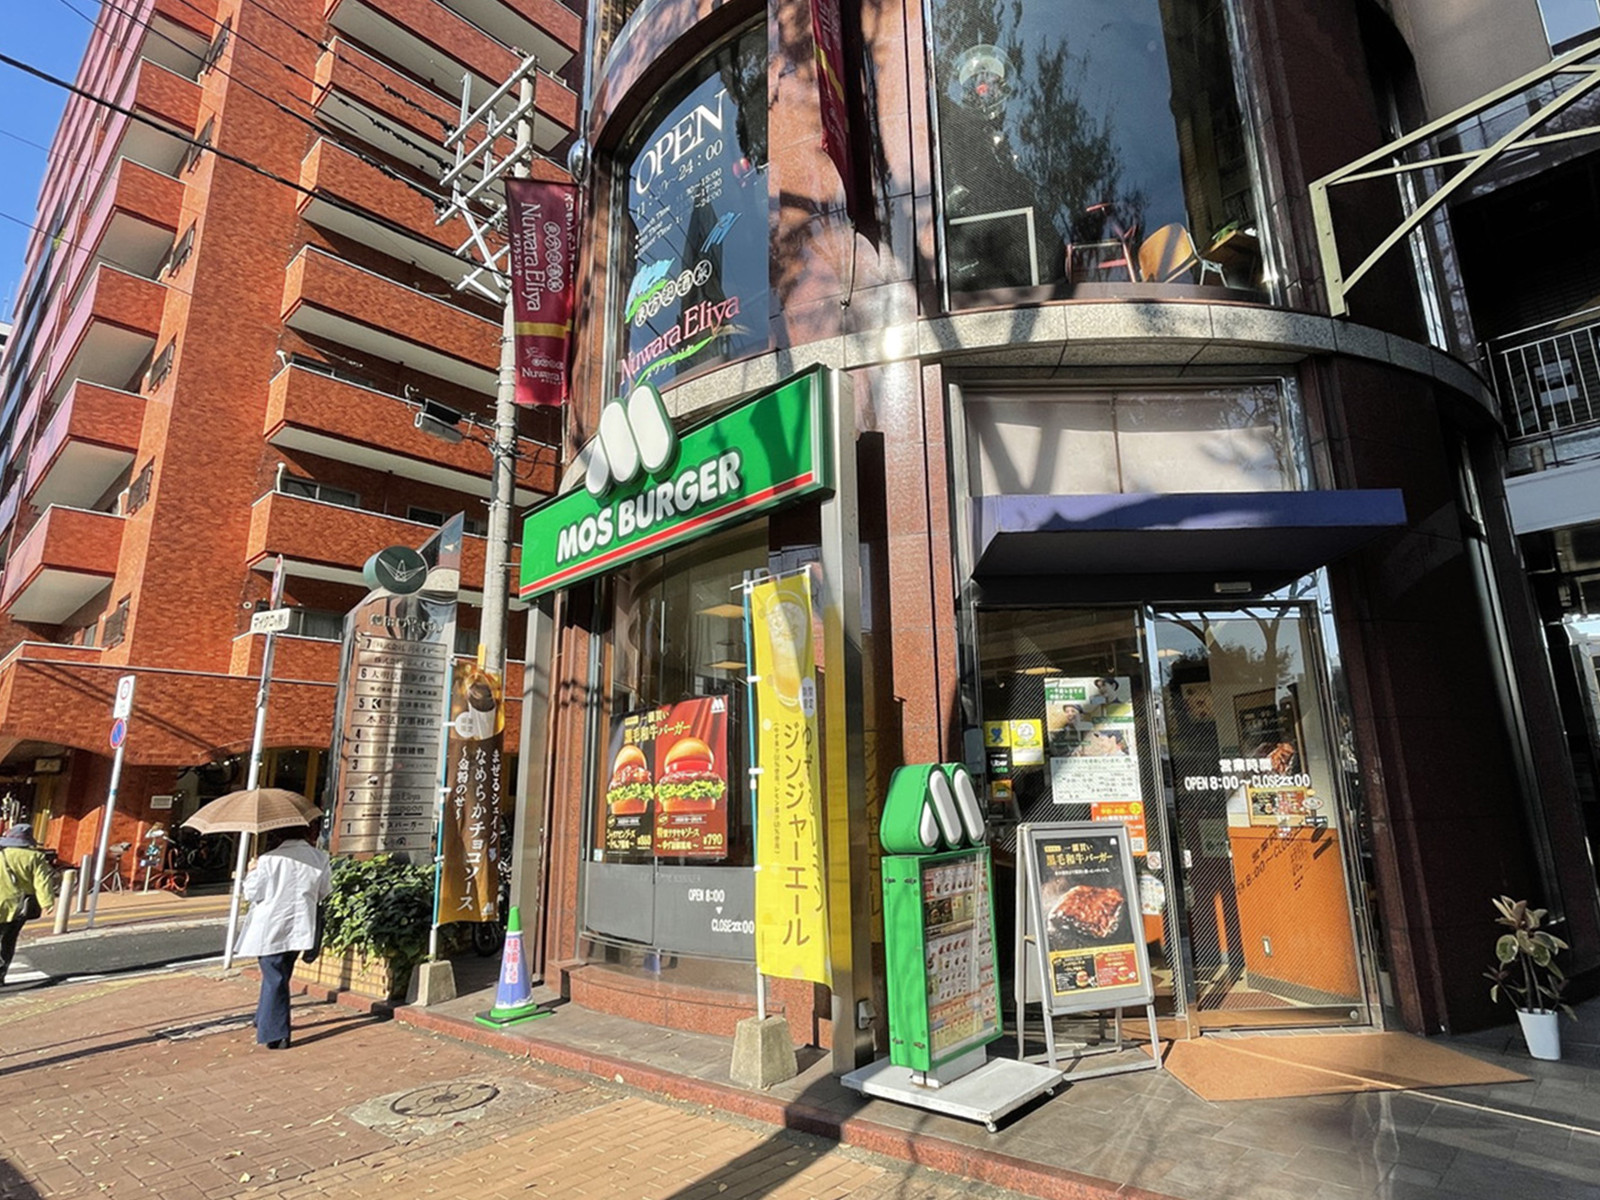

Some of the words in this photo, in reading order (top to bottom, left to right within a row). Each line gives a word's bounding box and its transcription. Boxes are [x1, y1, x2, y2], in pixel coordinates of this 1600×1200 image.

[636, 88, 728, 194] OPEN
[521, 202, 541, 267] Nuwara
[521, 269, 546, 311] Eliya
[620, 324, 682, 385] Nuwara
[683, 296, 740, 339] Eliya
[556, 506, 613, 564] MOS
[618, 451, 740, 537] BURGER
[365, 639, 372, 649] 7
[361, 668, 367, 678] 6
[359, 698, 365, 708] 5
[356, 729, 360, 739] 4
[354, 744, 359, 754] 4
[352, 759, 358, 770] 3
[1219, 758, 1272, 773] 営業時間
[1184, 776, 1209, 790] OPEN
[349, 790, 355, 801] 2
[490, 748, 501, 844] まぜるシェイク
[347, 823, 351, 833] 1
[457, 747, 487, 912] なめらかチョコソース
[783, 721, 810, 946] ジンジャーエール
[1046, 851, 1113, 866] 黒毛和牛バーガー
[688, 889, 704, 901] OPEN
[705, 889, 725, 902] 8:00
